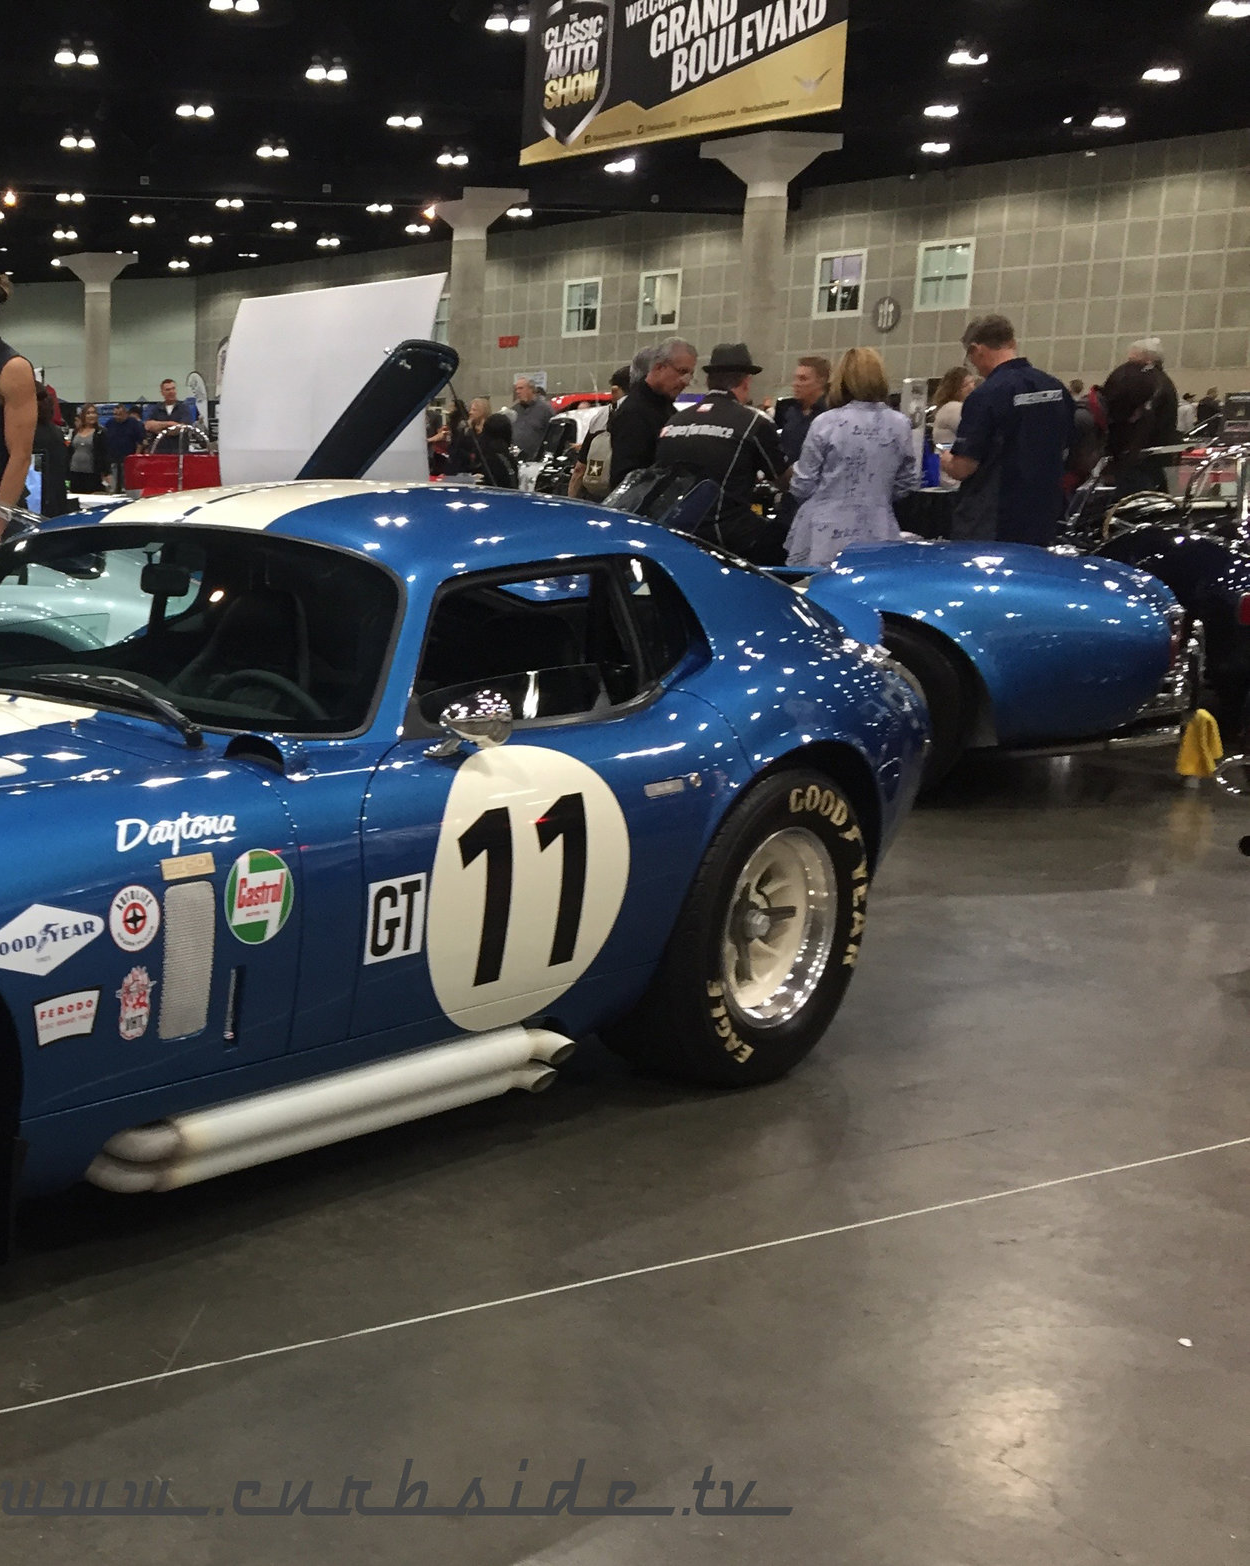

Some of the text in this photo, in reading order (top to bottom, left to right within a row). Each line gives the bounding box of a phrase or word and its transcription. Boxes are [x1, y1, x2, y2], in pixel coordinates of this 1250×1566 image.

[544, 15, 603, 50] CLASSIC
[624, 0, 683, 28] WELCO
[650, 0, 737, 58] GRAND
[545, 39, 599, 80] AUTO
[670, 0, 827, 92] BOULEVARD
[543, 69, 600, 109] SHOW
[115, 811, 237, 855] Daytona
[237, 872, 284, 909] Castrol
[458, 792, 588, 988] 11
[370, 879, 422, 957] GT
[39, 999, 94, 1021] FERODO
